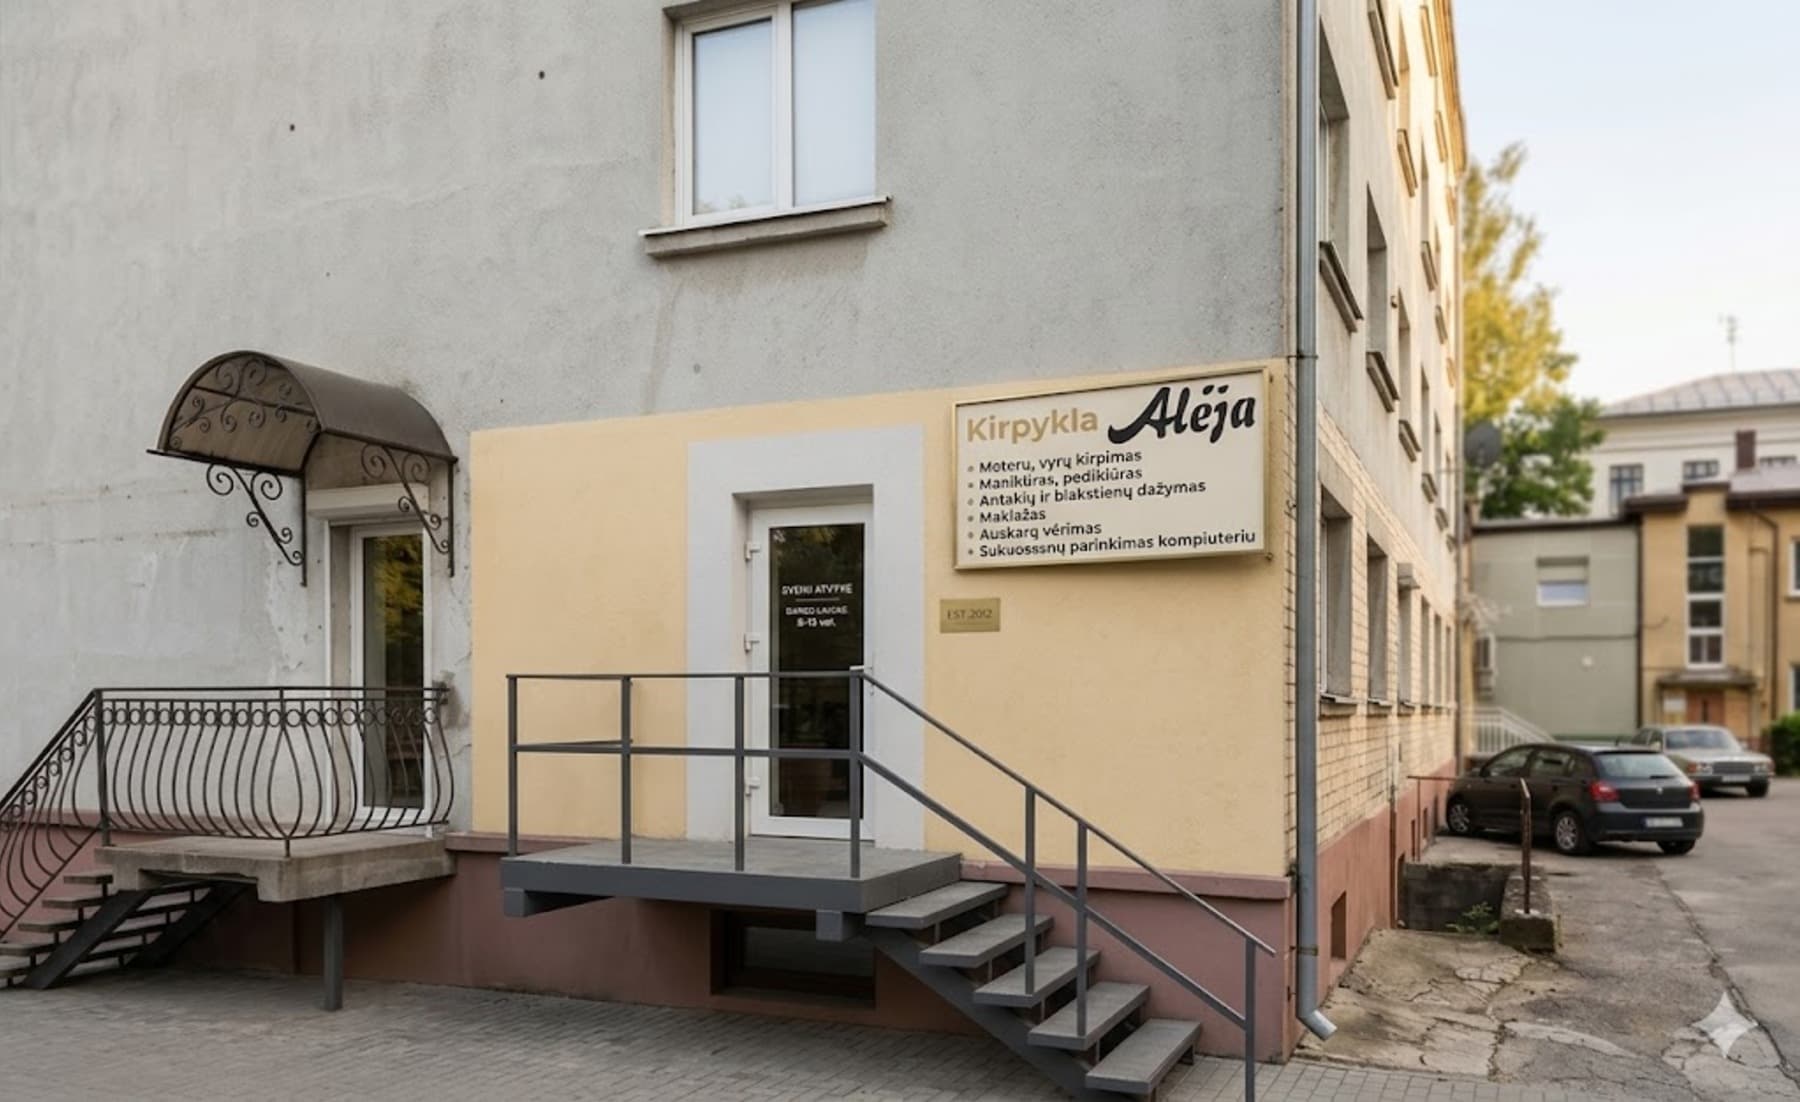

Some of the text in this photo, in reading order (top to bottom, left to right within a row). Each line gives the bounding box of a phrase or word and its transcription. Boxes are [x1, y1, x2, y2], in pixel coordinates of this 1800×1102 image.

[967, 408, 1098, 443] Kirpykla
[1039, 457, 1071, 471] vyrų
[1076, 450, 1142, 467] kirpimas
[1063, 467, 1142, 486] pedikiūras
[1040, 489, 1050, 502] ir
[1055, 485, 1132, 502] blakstienų
[1137, 481, 1206, 497] dažymas
[980, 508, 1046, 522] Maklažas
[1070, 537, 1154, 555] parinkimas
[1158, 529, 1256, 548] kompiuteriu
